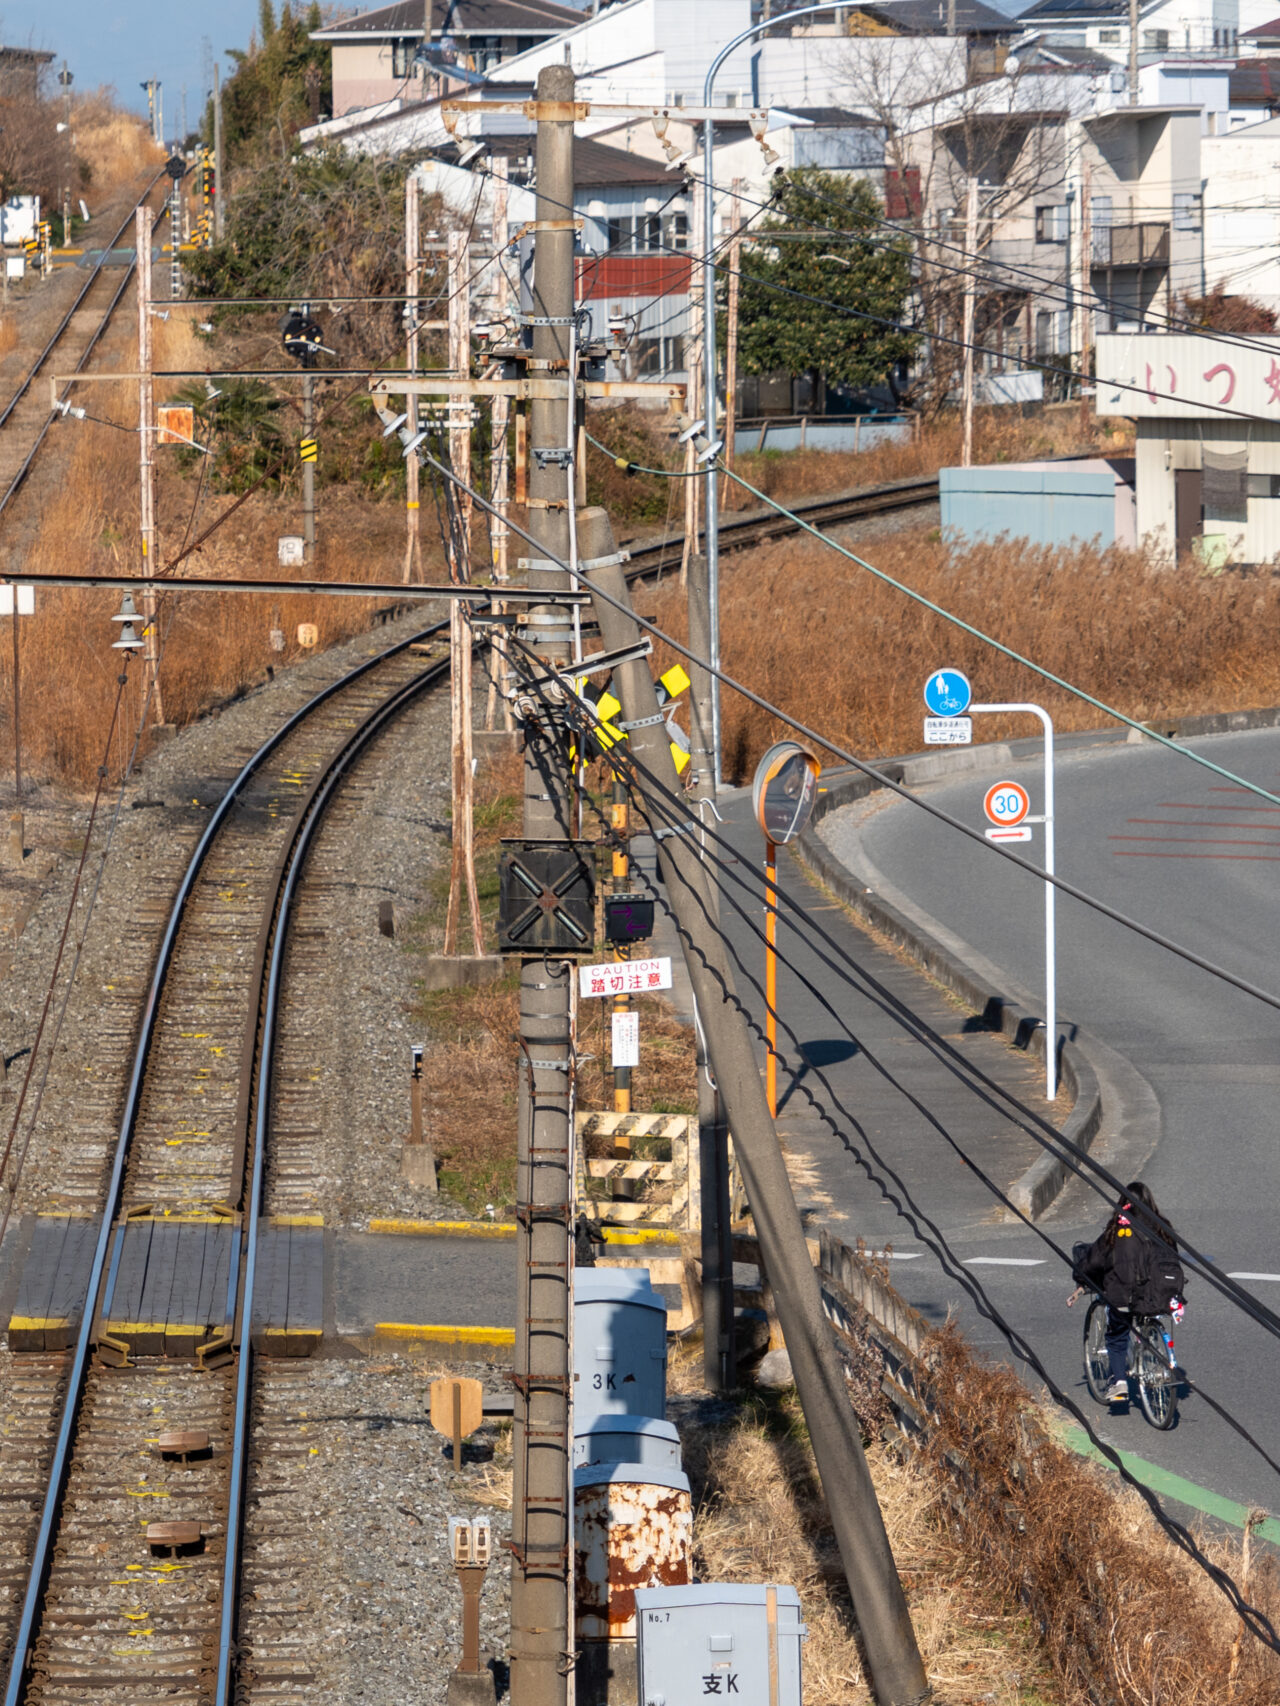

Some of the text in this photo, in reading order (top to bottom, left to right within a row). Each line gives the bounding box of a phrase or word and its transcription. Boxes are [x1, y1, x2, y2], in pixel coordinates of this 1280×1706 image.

[929, 732, 967, 742] ここから
[995, 794, 1019, 814] 30
[591, 961, 660, 977] CAUTION
[591, 972, 662, 993] 踏切注意
[648, 1612, 671, 1624] No.7
